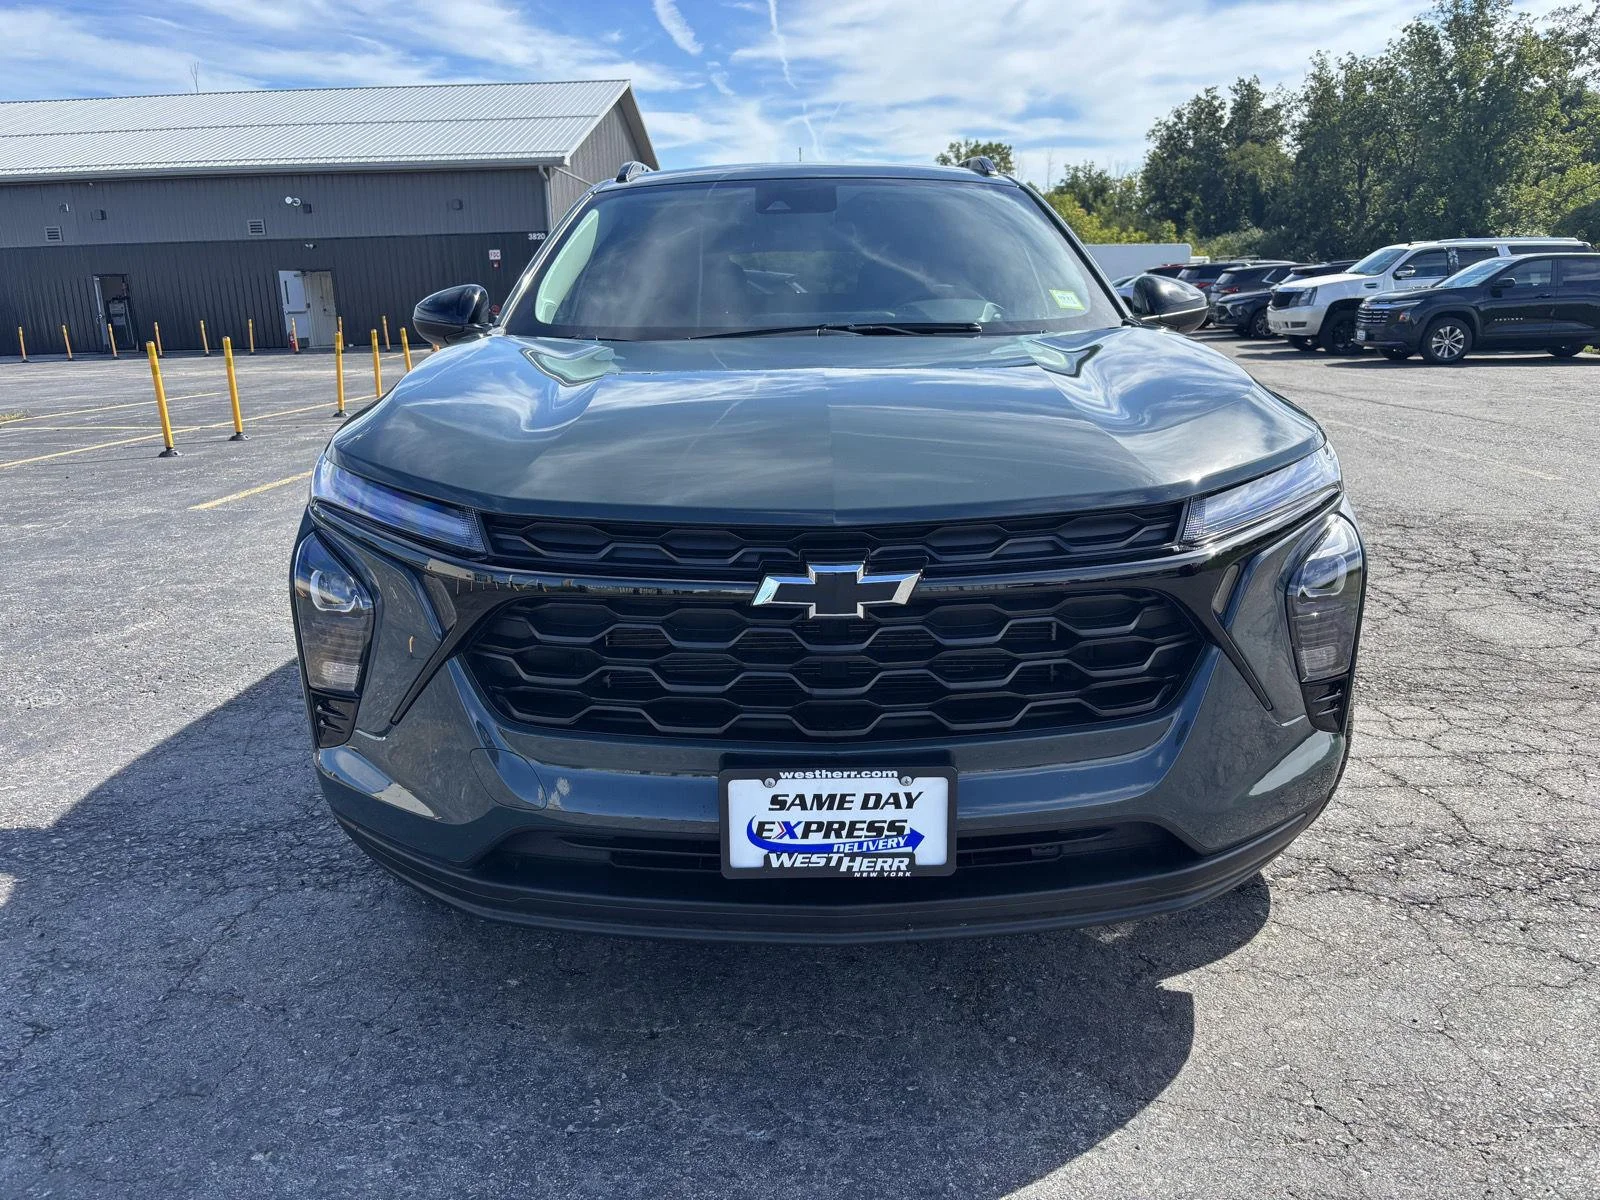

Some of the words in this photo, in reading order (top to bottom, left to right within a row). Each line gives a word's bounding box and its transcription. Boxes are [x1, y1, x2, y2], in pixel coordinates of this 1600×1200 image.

[779, 770, 898, 779] westherr.com
[768, 794, 856, 811] SAME
[860, 791, 924, 810] DAY
[755, 820, 908, 840] EXPRESS
[833, 835, 909, 853] DELIVERY
